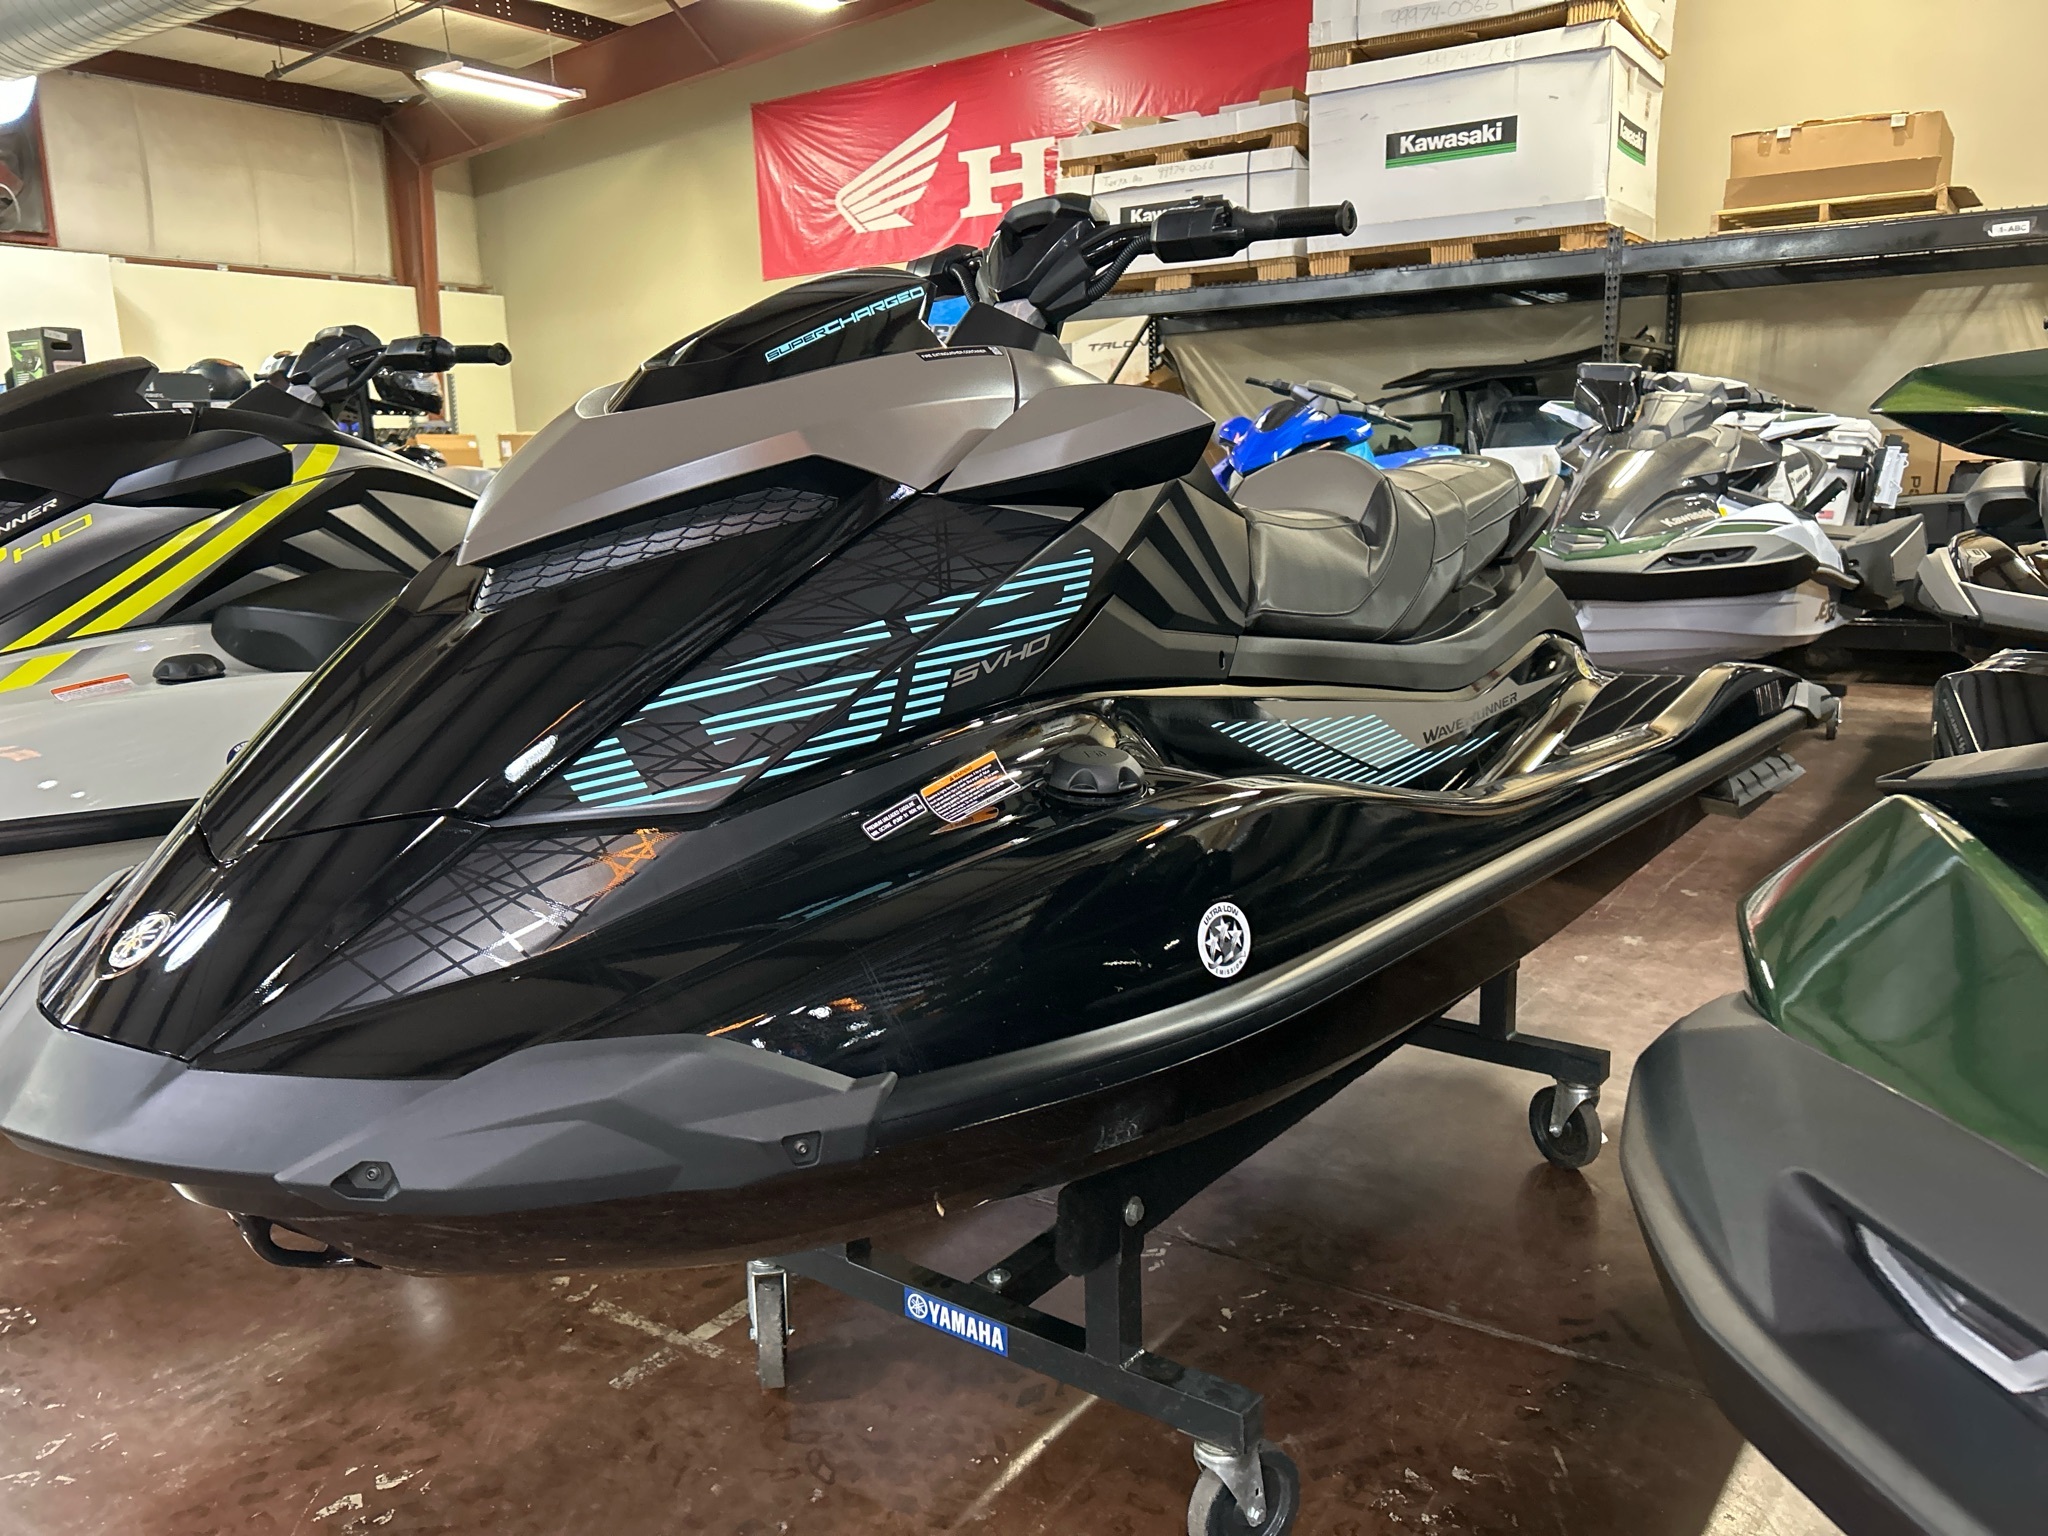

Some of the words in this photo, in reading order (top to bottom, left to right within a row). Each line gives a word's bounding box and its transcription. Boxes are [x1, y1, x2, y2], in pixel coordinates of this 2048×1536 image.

[1399, 122, 1503, 154] Kawasaki
[765, 285, 926, 362] SUPERCHARGED
[951, 633, 1051, 688] SVHO
[1203, 905, 1222, 926] ULTRA
[1223, 904, 1239, 916] LOW
[1215, 959, 1243, 976] EMISSION
[928, 1300, 1004, 1351] YAMAHA
